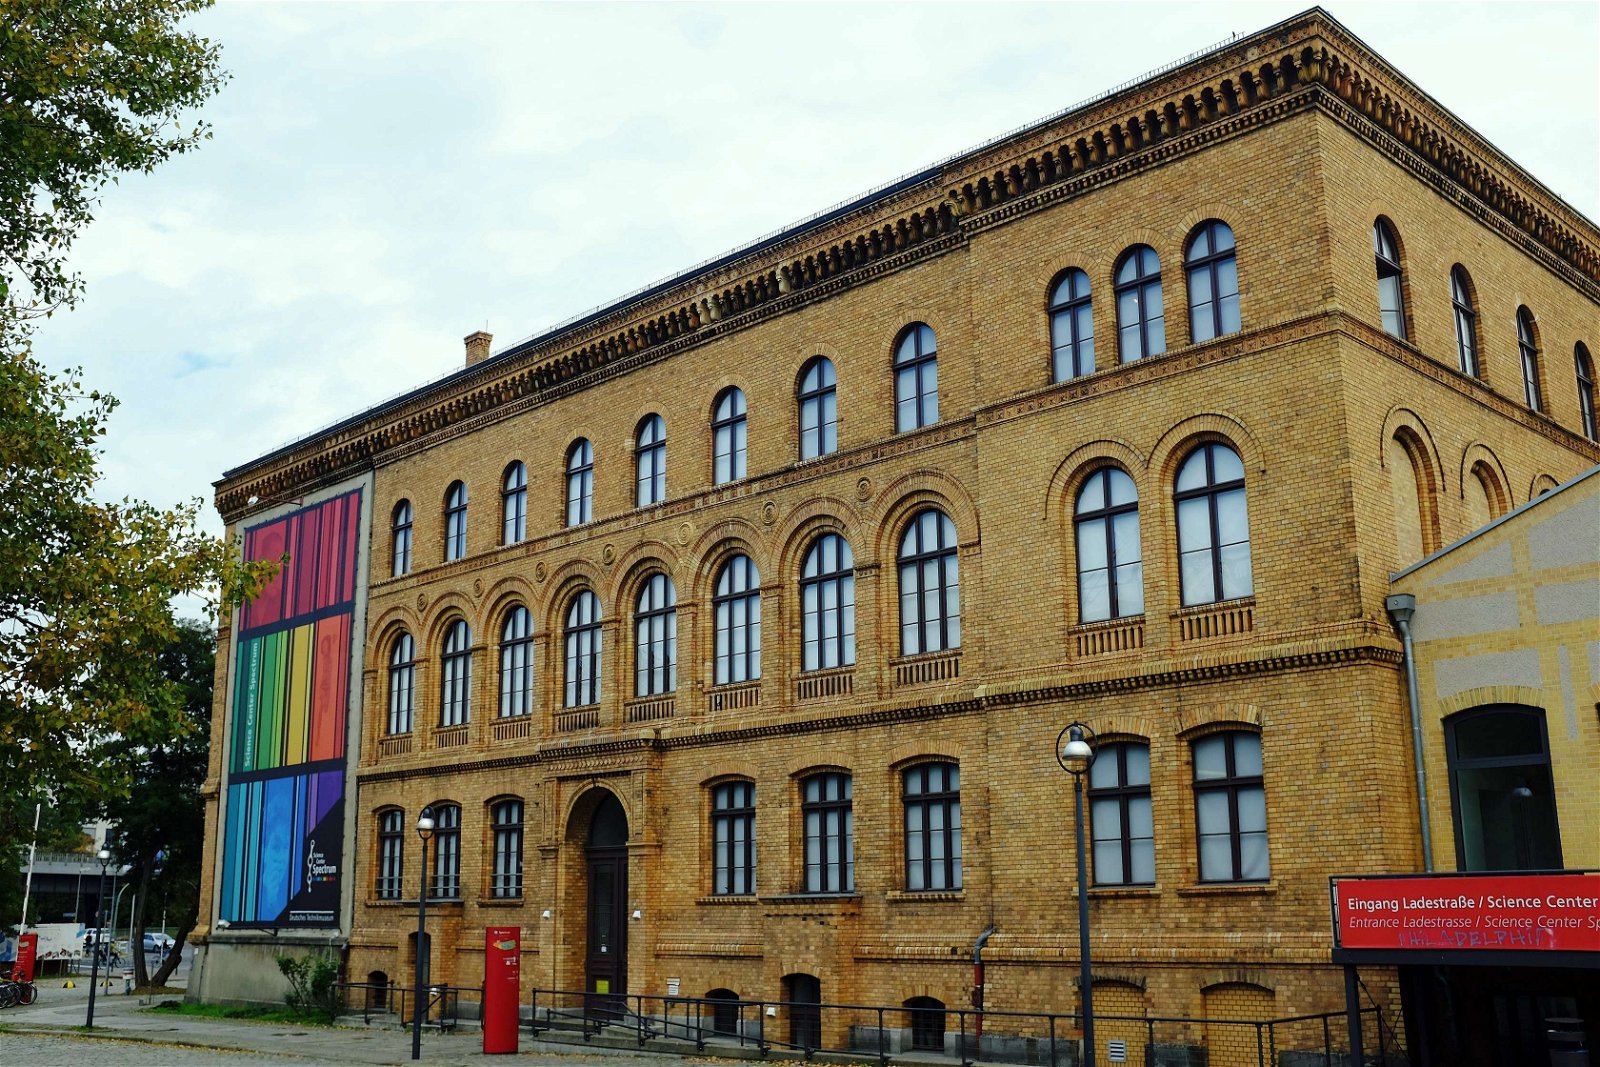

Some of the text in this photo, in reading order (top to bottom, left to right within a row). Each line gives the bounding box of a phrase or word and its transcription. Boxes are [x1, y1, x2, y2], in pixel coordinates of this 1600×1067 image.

[245, 729, 253, 767] Science
[250, 642, 258, 690] Spectrum
[312, 864, 336, 876] Spectrum
[1348, 895, 1599, 912] Eingang Ladestraße / Science Center
[1349, 916, 1399, 928] Entrance
[1403, 916, 1472, 928] Ladestrasse
[1475, 915, 1481, 928] /
[1485, 915, 1533, 928] Science
[1537, 915, 1583, 928] Center
